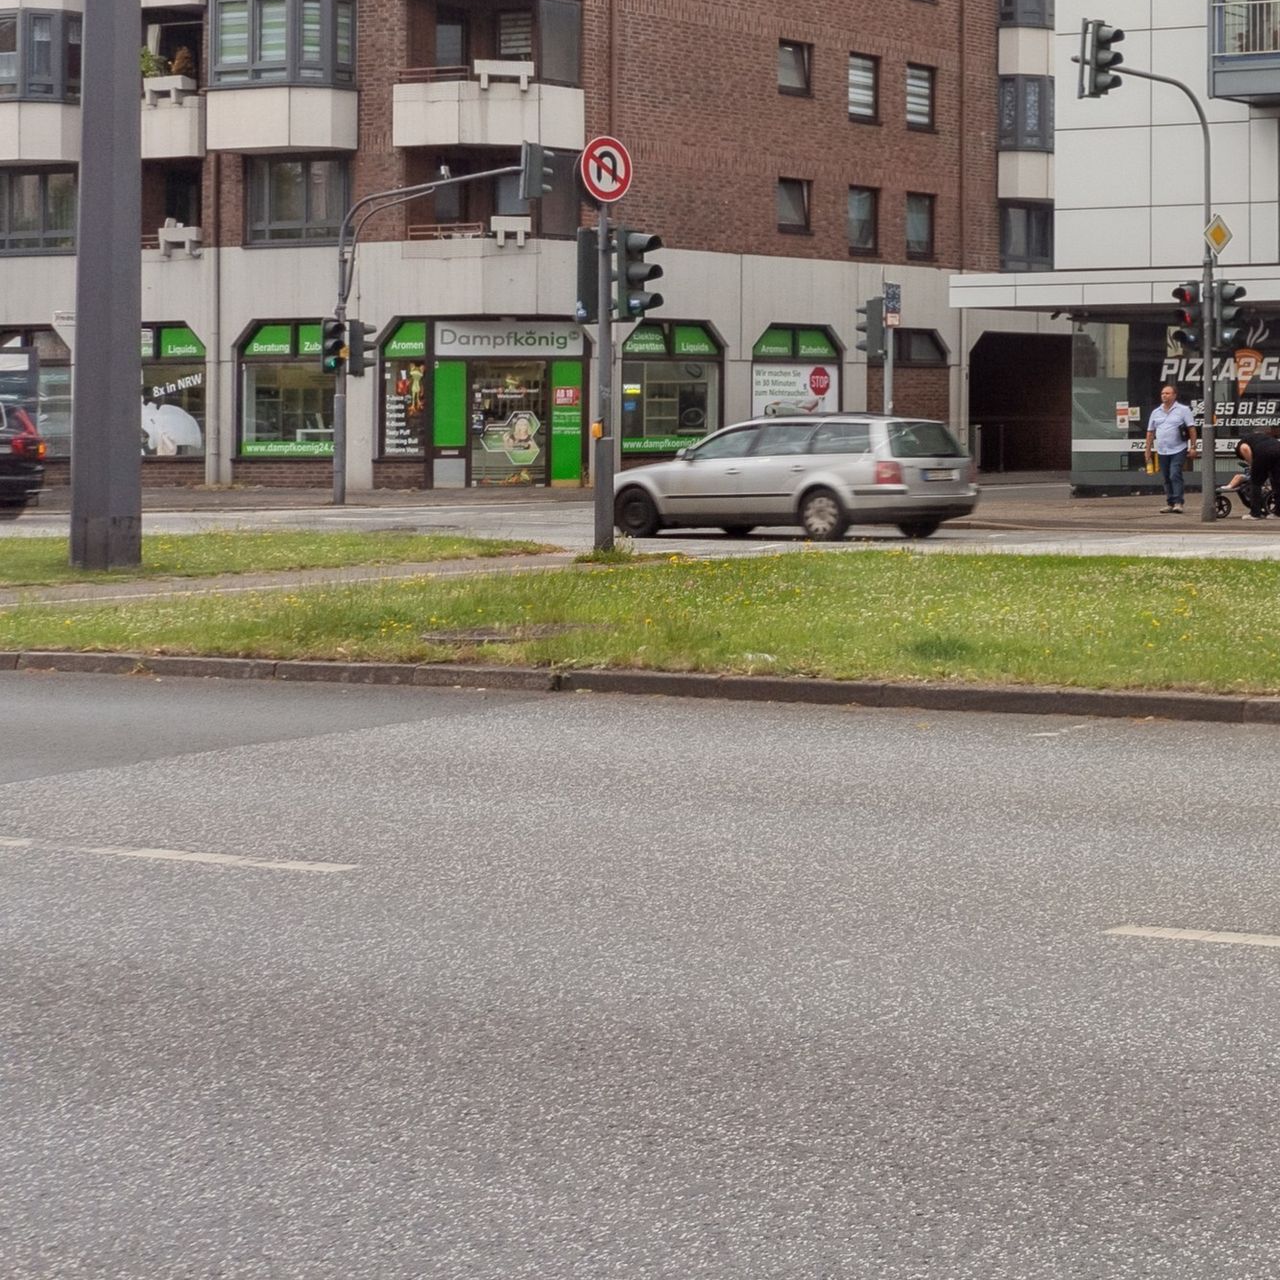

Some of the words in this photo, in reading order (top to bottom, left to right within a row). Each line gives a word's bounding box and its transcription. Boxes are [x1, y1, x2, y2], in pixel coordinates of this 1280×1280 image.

[440, 328, 568, 350] Dampfkönig
[168, 345, 197, 354] Liquids
[253, 343, 290, 354] Beratung
[391, 341, 424, 350] Aromen
[626, 342, 665, 352] Zigaretten
[681, 343, 709, 353] Liquids
[761, 345, 788, 353] Aromen
[800, 345, 828, 354] Zubehör
[755, 369, 767, 377] Wir
[768, 369, 790, 377] machen
[153, 384, 165, 397] 8x
[165, 381, 177, 394] in
[177, 373, 202, 390] NRW
[811, 375, 828, 388] STOP
[1215, 401, 1235, 415] 55
[1237, 401, 1253, 415] 81
[1256, 401, 1276, 415] 59
